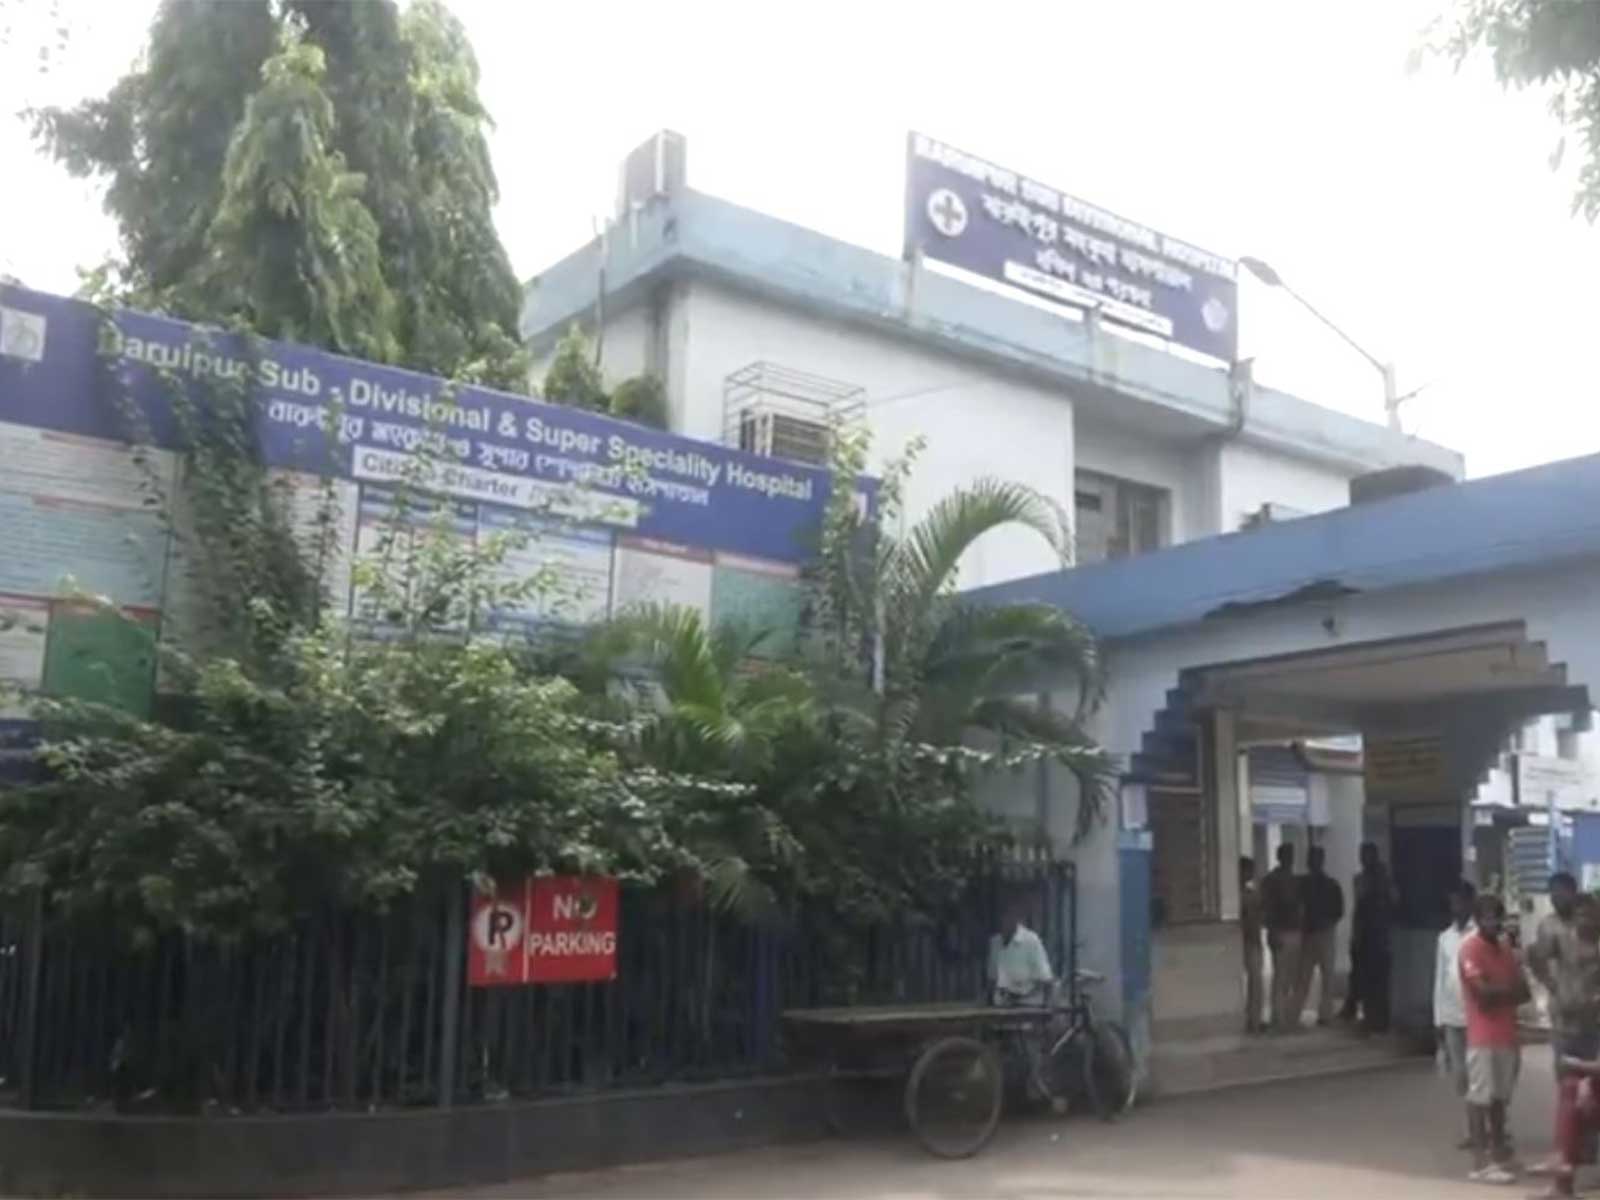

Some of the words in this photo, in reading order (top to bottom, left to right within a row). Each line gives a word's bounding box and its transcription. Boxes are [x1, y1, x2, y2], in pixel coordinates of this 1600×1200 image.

[259, 359, 321, 397] Sub
[349, 379, 490, 433] Divisional
[497, 412, 520, 439] &
[525, 418, 602, 462] Super
[607, 435, 722, 488] Speciality
[726, 461, 814, 501] Hospital
[443, 467, 519, 497] Charter
[551, 893, 598, 921] NO
[528, 932, 617, 956] PARKING
